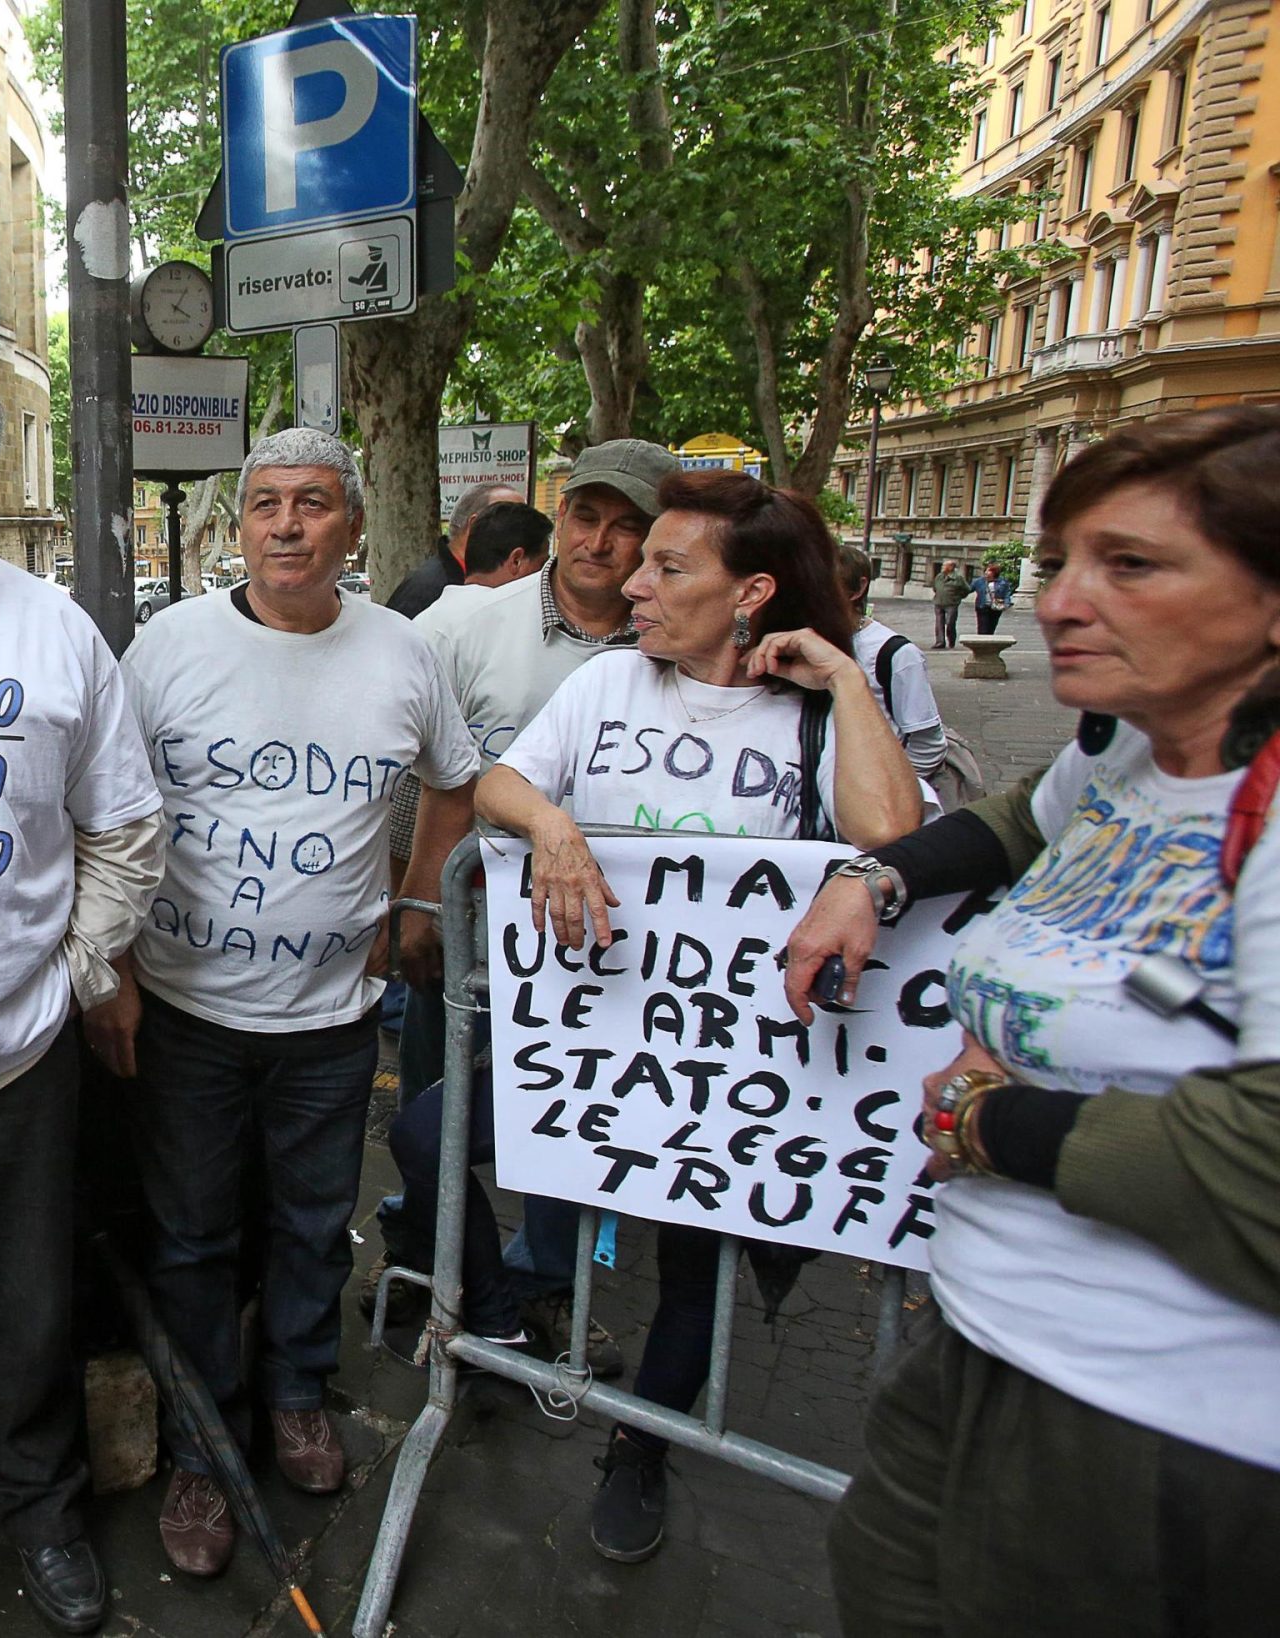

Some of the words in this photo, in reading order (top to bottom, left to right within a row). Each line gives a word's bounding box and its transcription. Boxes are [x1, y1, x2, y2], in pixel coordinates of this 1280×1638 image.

[263, 40, 378, 213] P
[169, 269, 181, 280] 12
[238, 268, 333, 296] riservato:
[200, 302, 208, 313] 3
[163, 395, 239, 418] DISPONIBILE
[134, 420, 222, 435] 06.81.23.851
[439, 475, 460, 484] INEST
[463, 474, 498, 484] WALKING
[500, 473, 525, 482] SHOES
[171, 813, 336, 875] FINO
[230, 876, 266, 915] A
[511, 982, 604, 1028] LE
[531, 1099, 620, 1142] LE
